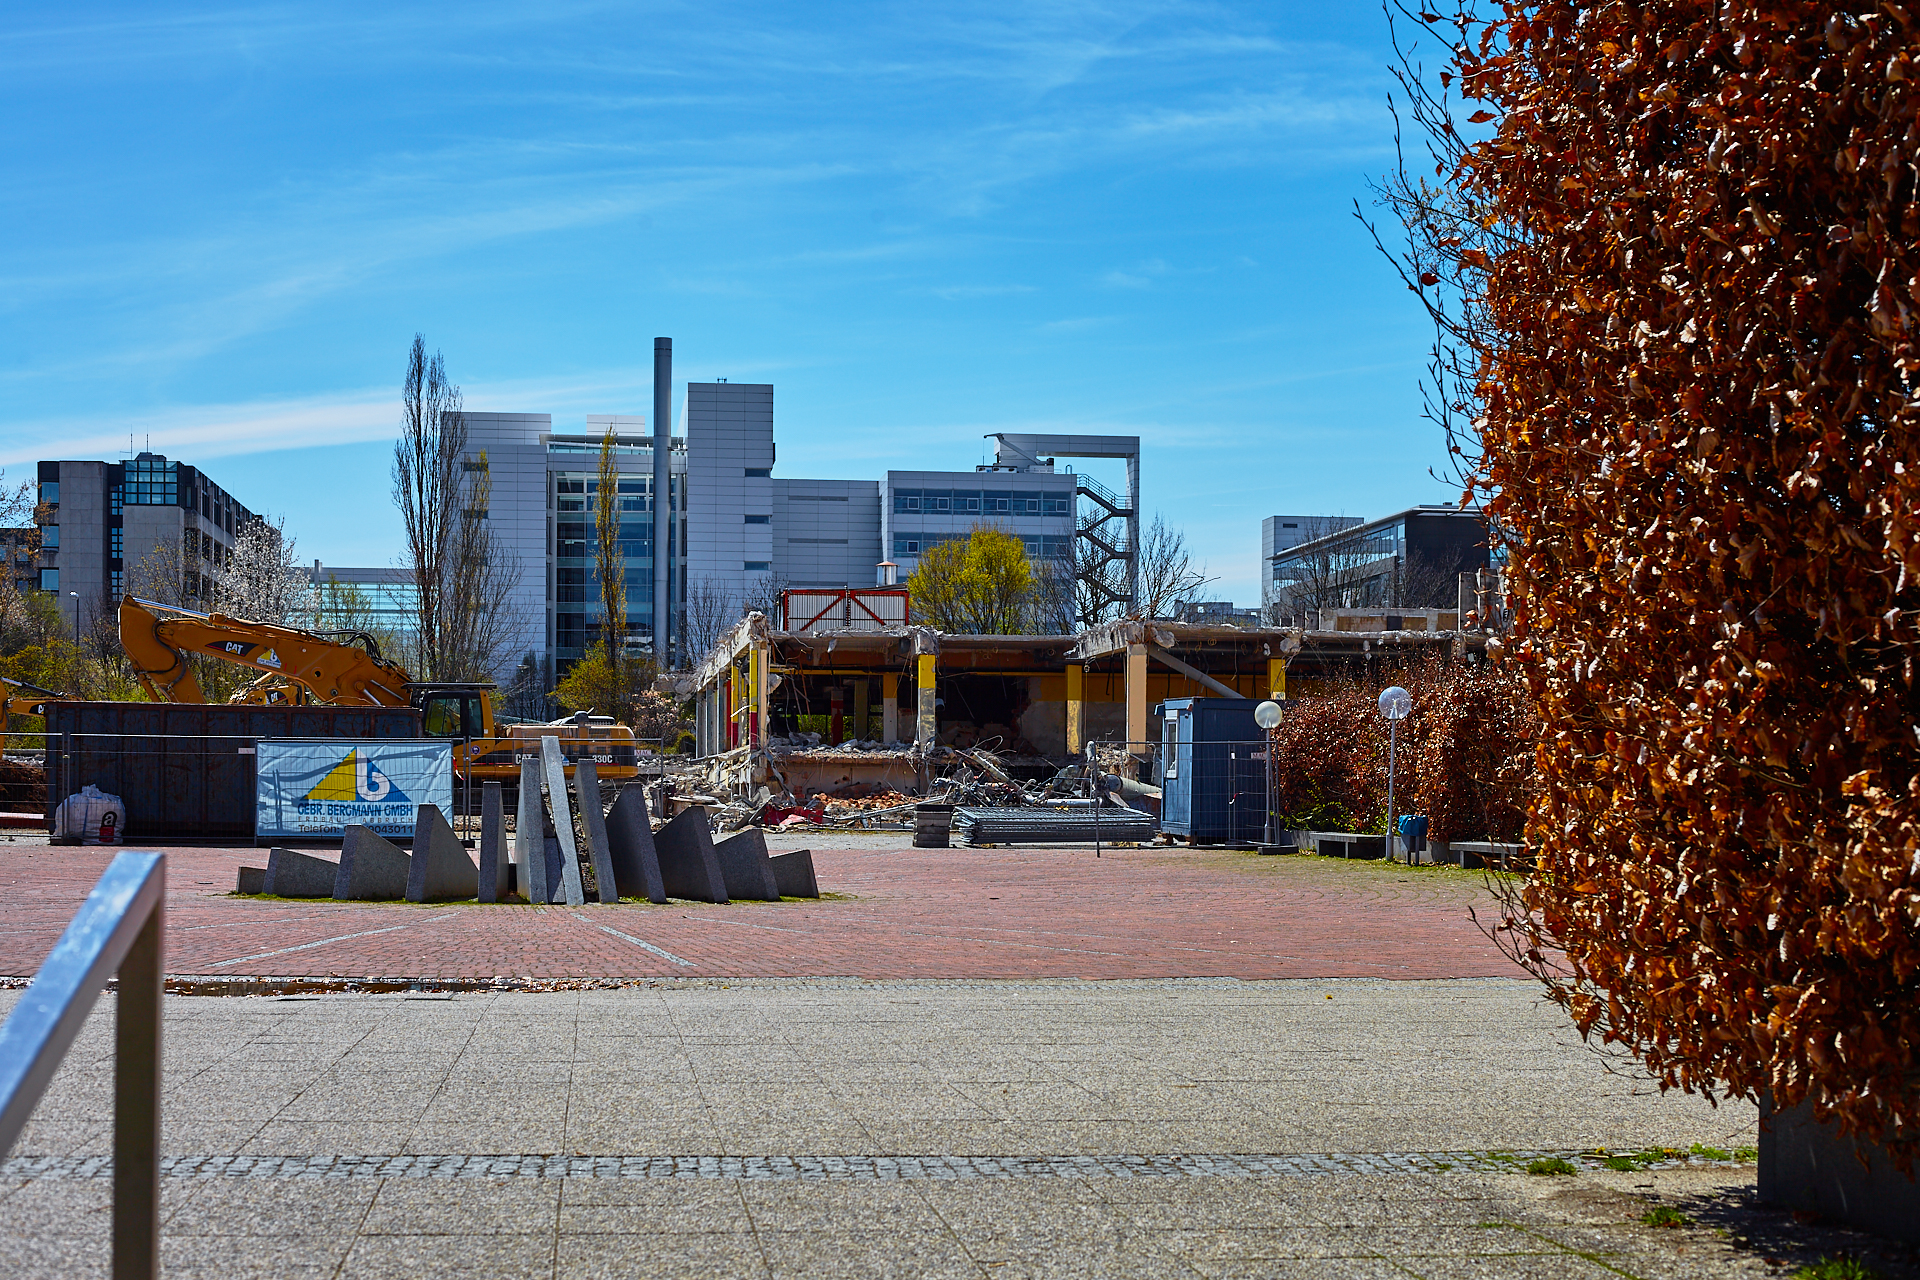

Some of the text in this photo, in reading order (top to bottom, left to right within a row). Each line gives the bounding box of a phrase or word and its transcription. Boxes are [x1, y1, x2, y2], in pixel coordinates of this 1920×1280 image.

[225, 641, 244, 655] CAT
[298, 803, 413, 817] GEBR. BERGMANN GMBH
[103, 813, 114, 826] a
[298, 824, 340, 833] Telefon:
